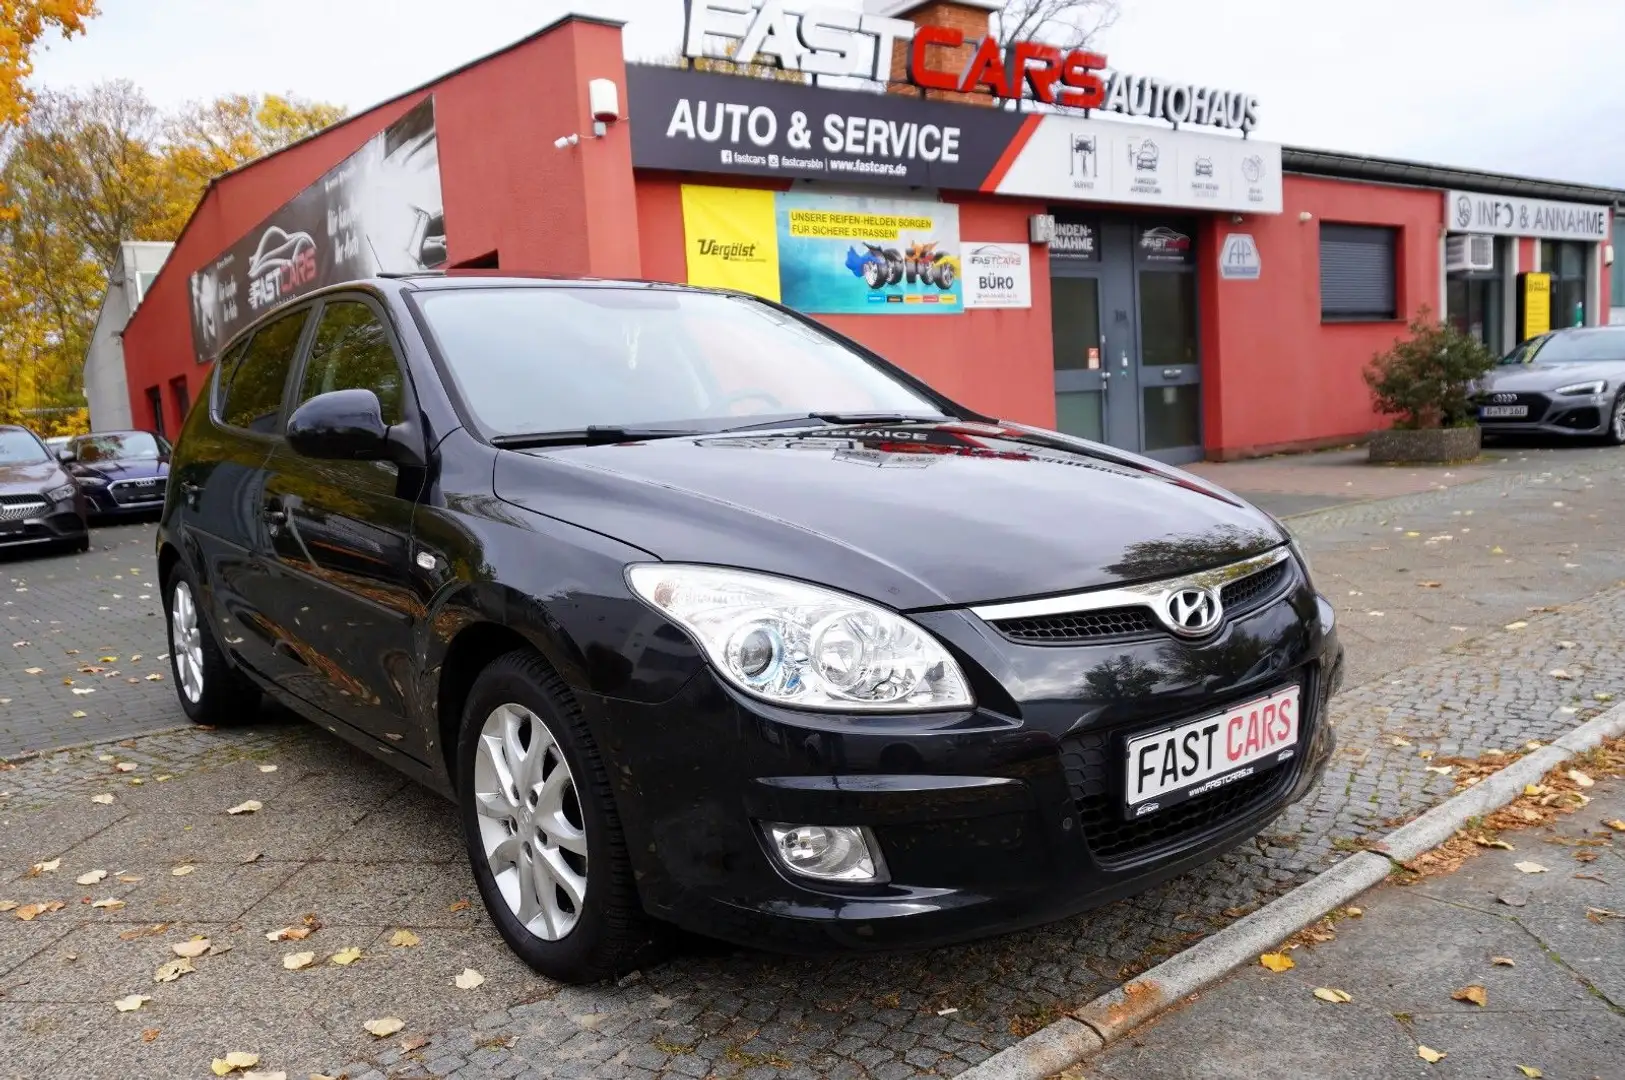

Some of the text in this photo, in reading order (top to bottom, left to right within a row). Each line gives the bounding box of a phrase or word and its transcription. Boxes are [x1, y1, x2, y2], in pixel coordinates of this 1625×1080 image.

[1103, 72, 1260, 133] AUTOHAUS
[667, 98, 961, 164] AUTO & SERVICE
[734, 152, 766, 166] fastcars
[830, 159, 907, 177] www.fastcars.de
[791, 212, 932, 229] UNSERE REIFEN-HELDEN SORGEN
[792, 225, 898, 239] FÜR SICHERE STRASSEN!
[1477, 201, 1604, 234] INFO & ANNAHME
[979, 271, 1014, 290] BÜRO
[1137, 698, 1292, 794] FAST CARS
